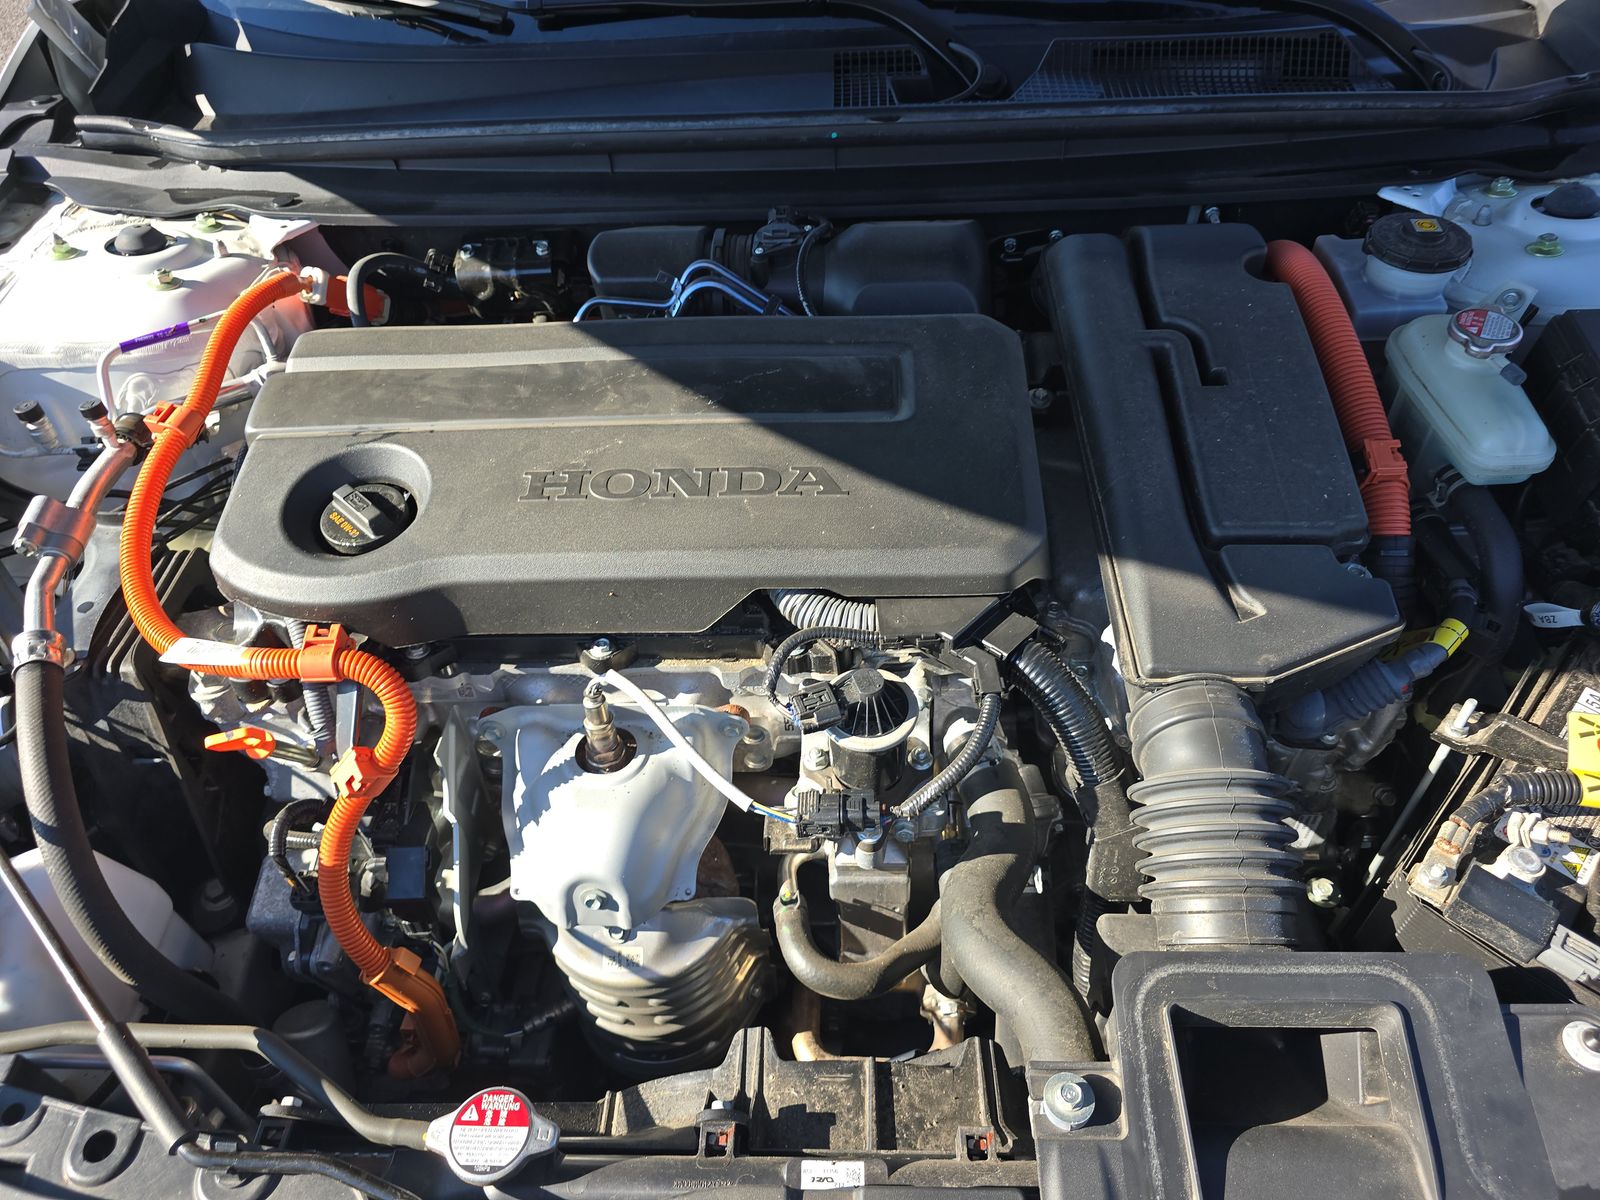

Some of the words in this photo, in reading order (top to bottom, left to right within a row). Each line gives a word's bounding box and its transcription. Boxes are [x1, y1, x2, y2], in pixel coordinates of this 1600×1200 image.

[518, 466, 850, 502] HONDA
[329, 511, 345, 525] SAE
[482, 1093, 515, 1102] DANGER
[481, 1101, 521, 1111] WARNUNG
